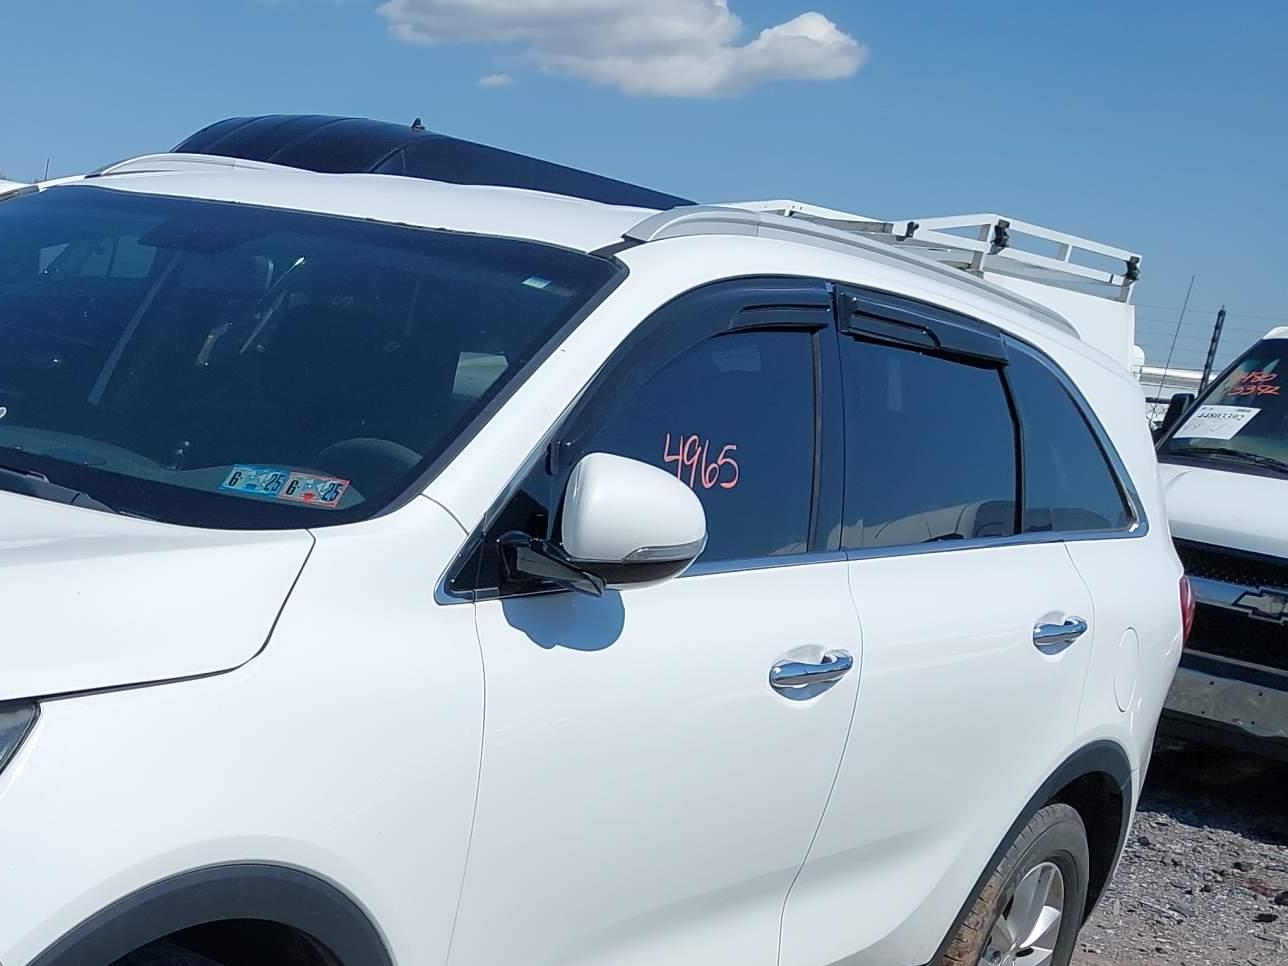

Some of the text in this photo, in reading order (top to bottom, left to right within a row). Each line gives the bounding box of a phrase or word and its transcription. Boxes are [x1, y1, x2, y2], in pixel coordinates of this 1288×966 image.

[664, 432, 739, 489] 4965
[228, 471, 286, 492] 6 25
[285, 479, 343, 502] 6 25
